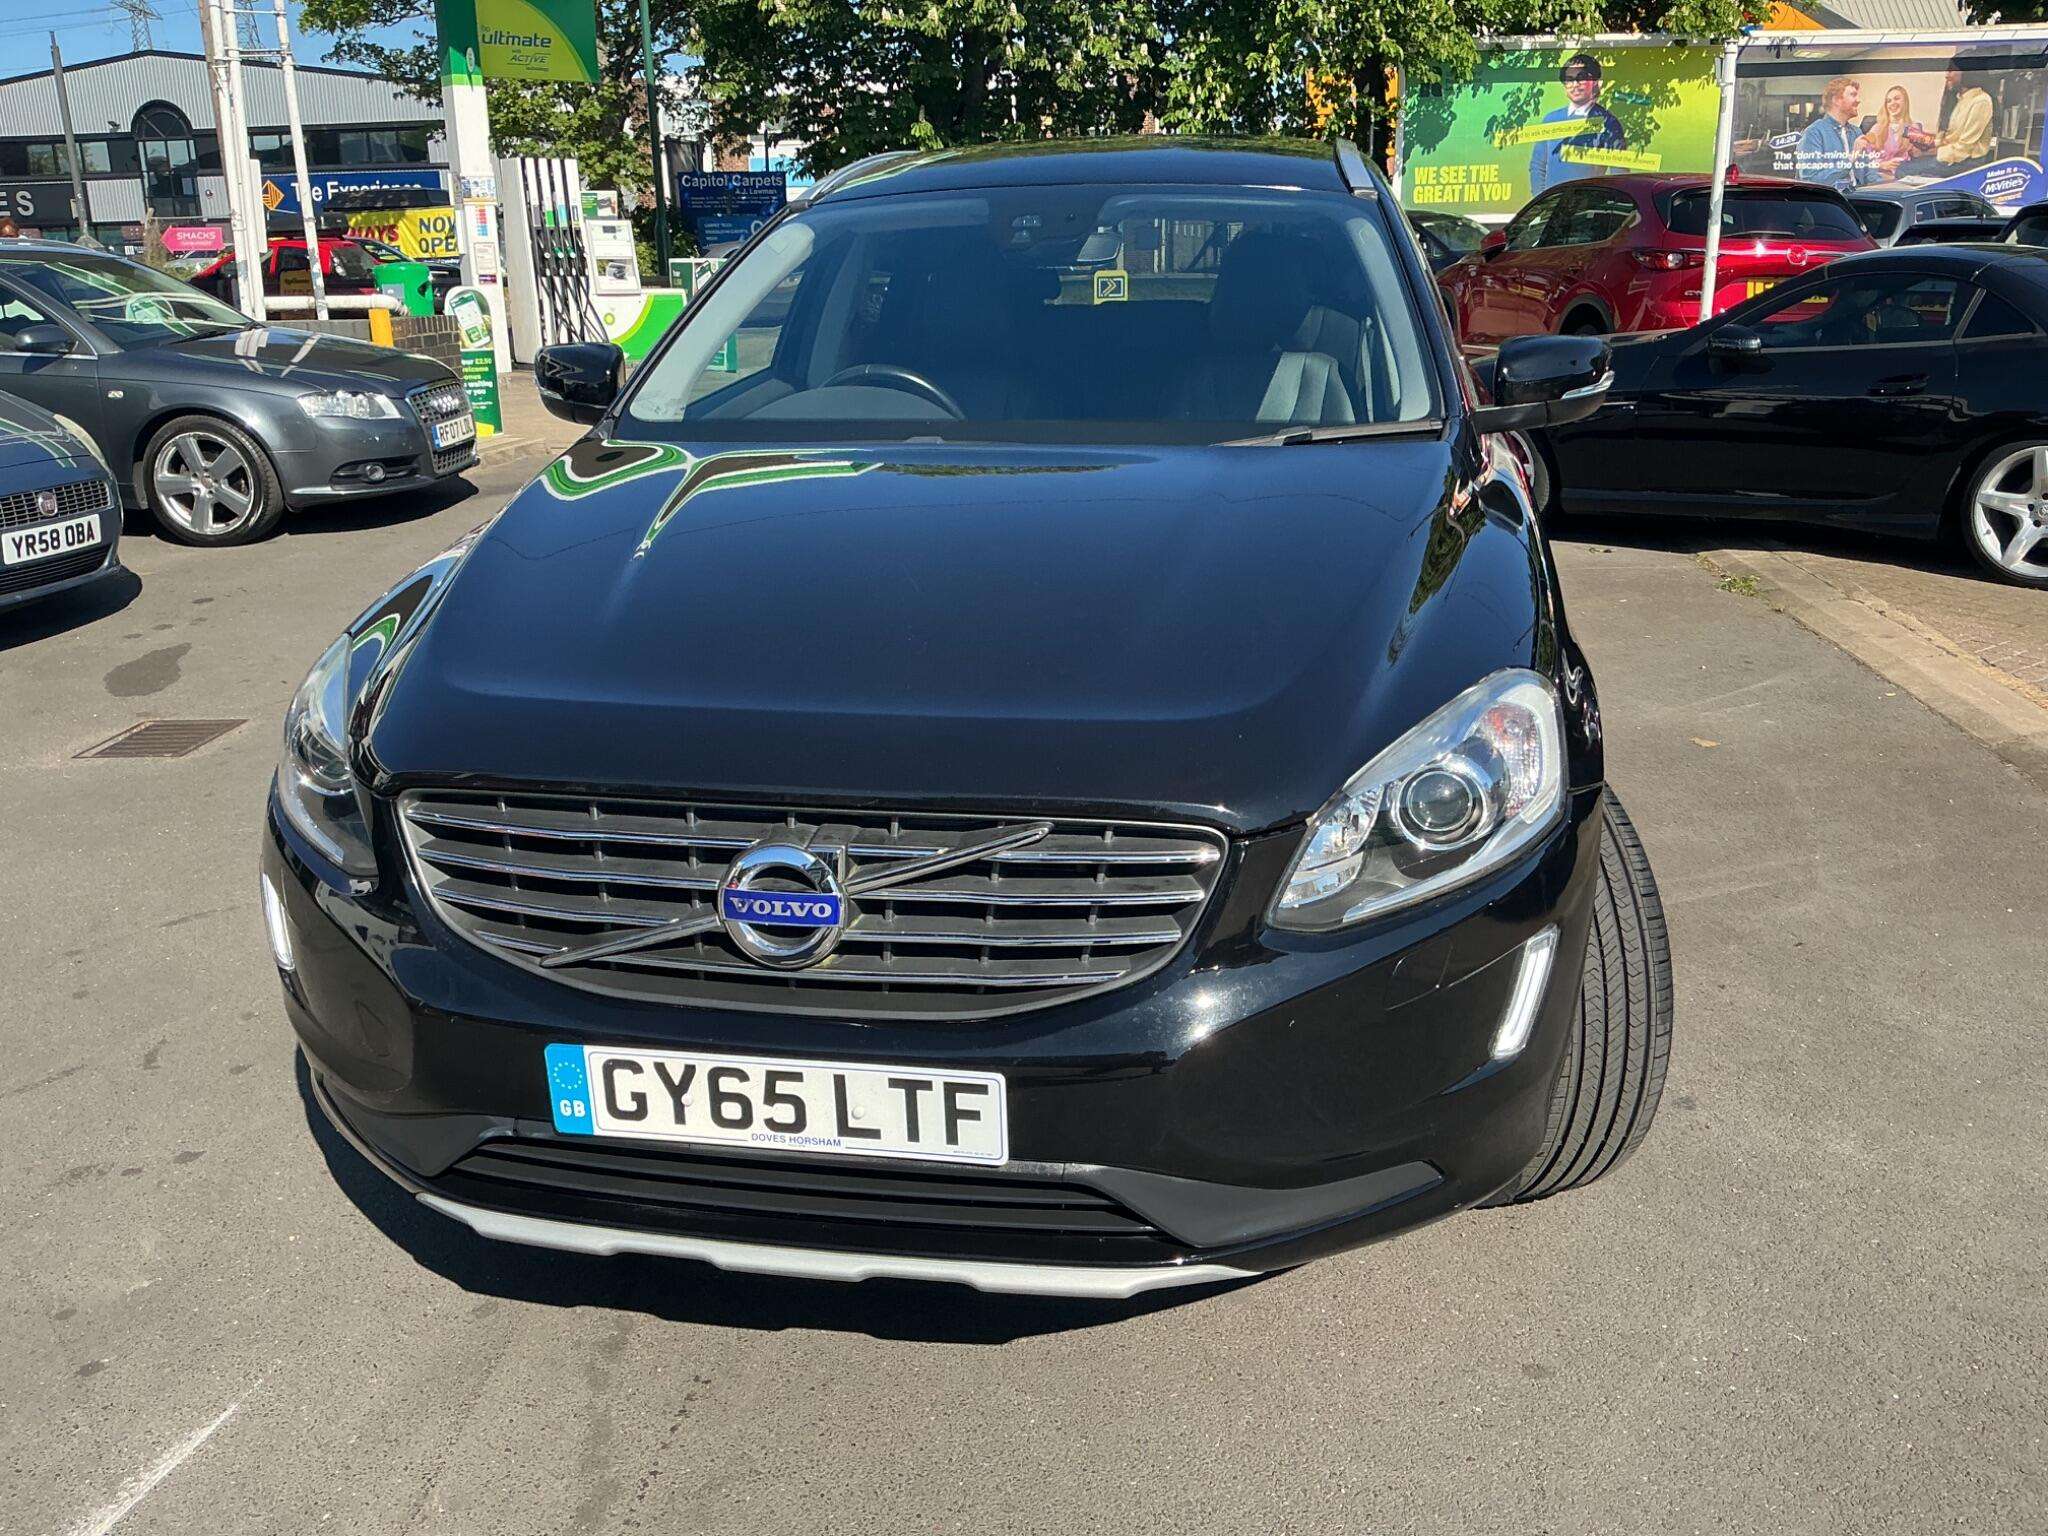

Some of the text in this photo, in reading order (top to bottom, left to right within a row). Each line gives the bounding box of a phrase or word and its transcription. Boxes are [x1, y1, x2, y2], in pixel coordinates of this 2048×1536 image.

[481, 31, 552, 48] ultimate
[510, 54, 547, 63] ACTIVE
[1774, 151, 1792, 160] The
[1415, 164, 1499, 185] WE SEE THE
[1773, 161, 1794, 170] that
[1795, 162, 1834, 172] escapes
[1836, 161, 1852, 169] the
[290, 181, 323, 202] Te
[681, 174, 784, 191] Capitol Carpets
[1413, 183, 1512, 204] GREAT IN YOU
[176, 231, 217, 241] SMACKS
[418, 235, 459, 254] OPE
[439, 421, 459, 442] RF07
[11, 520, 95, 558] YR58 OBA
[729, 897, 833, 918] VOLVO
[559, 1099, 586, 1118] GB
[602, 1058, 990, 1146] GY65 LTF
[751, 1132, 786, 1144] DOVES
[789, 1136, 842, 1148] HORSHAM
